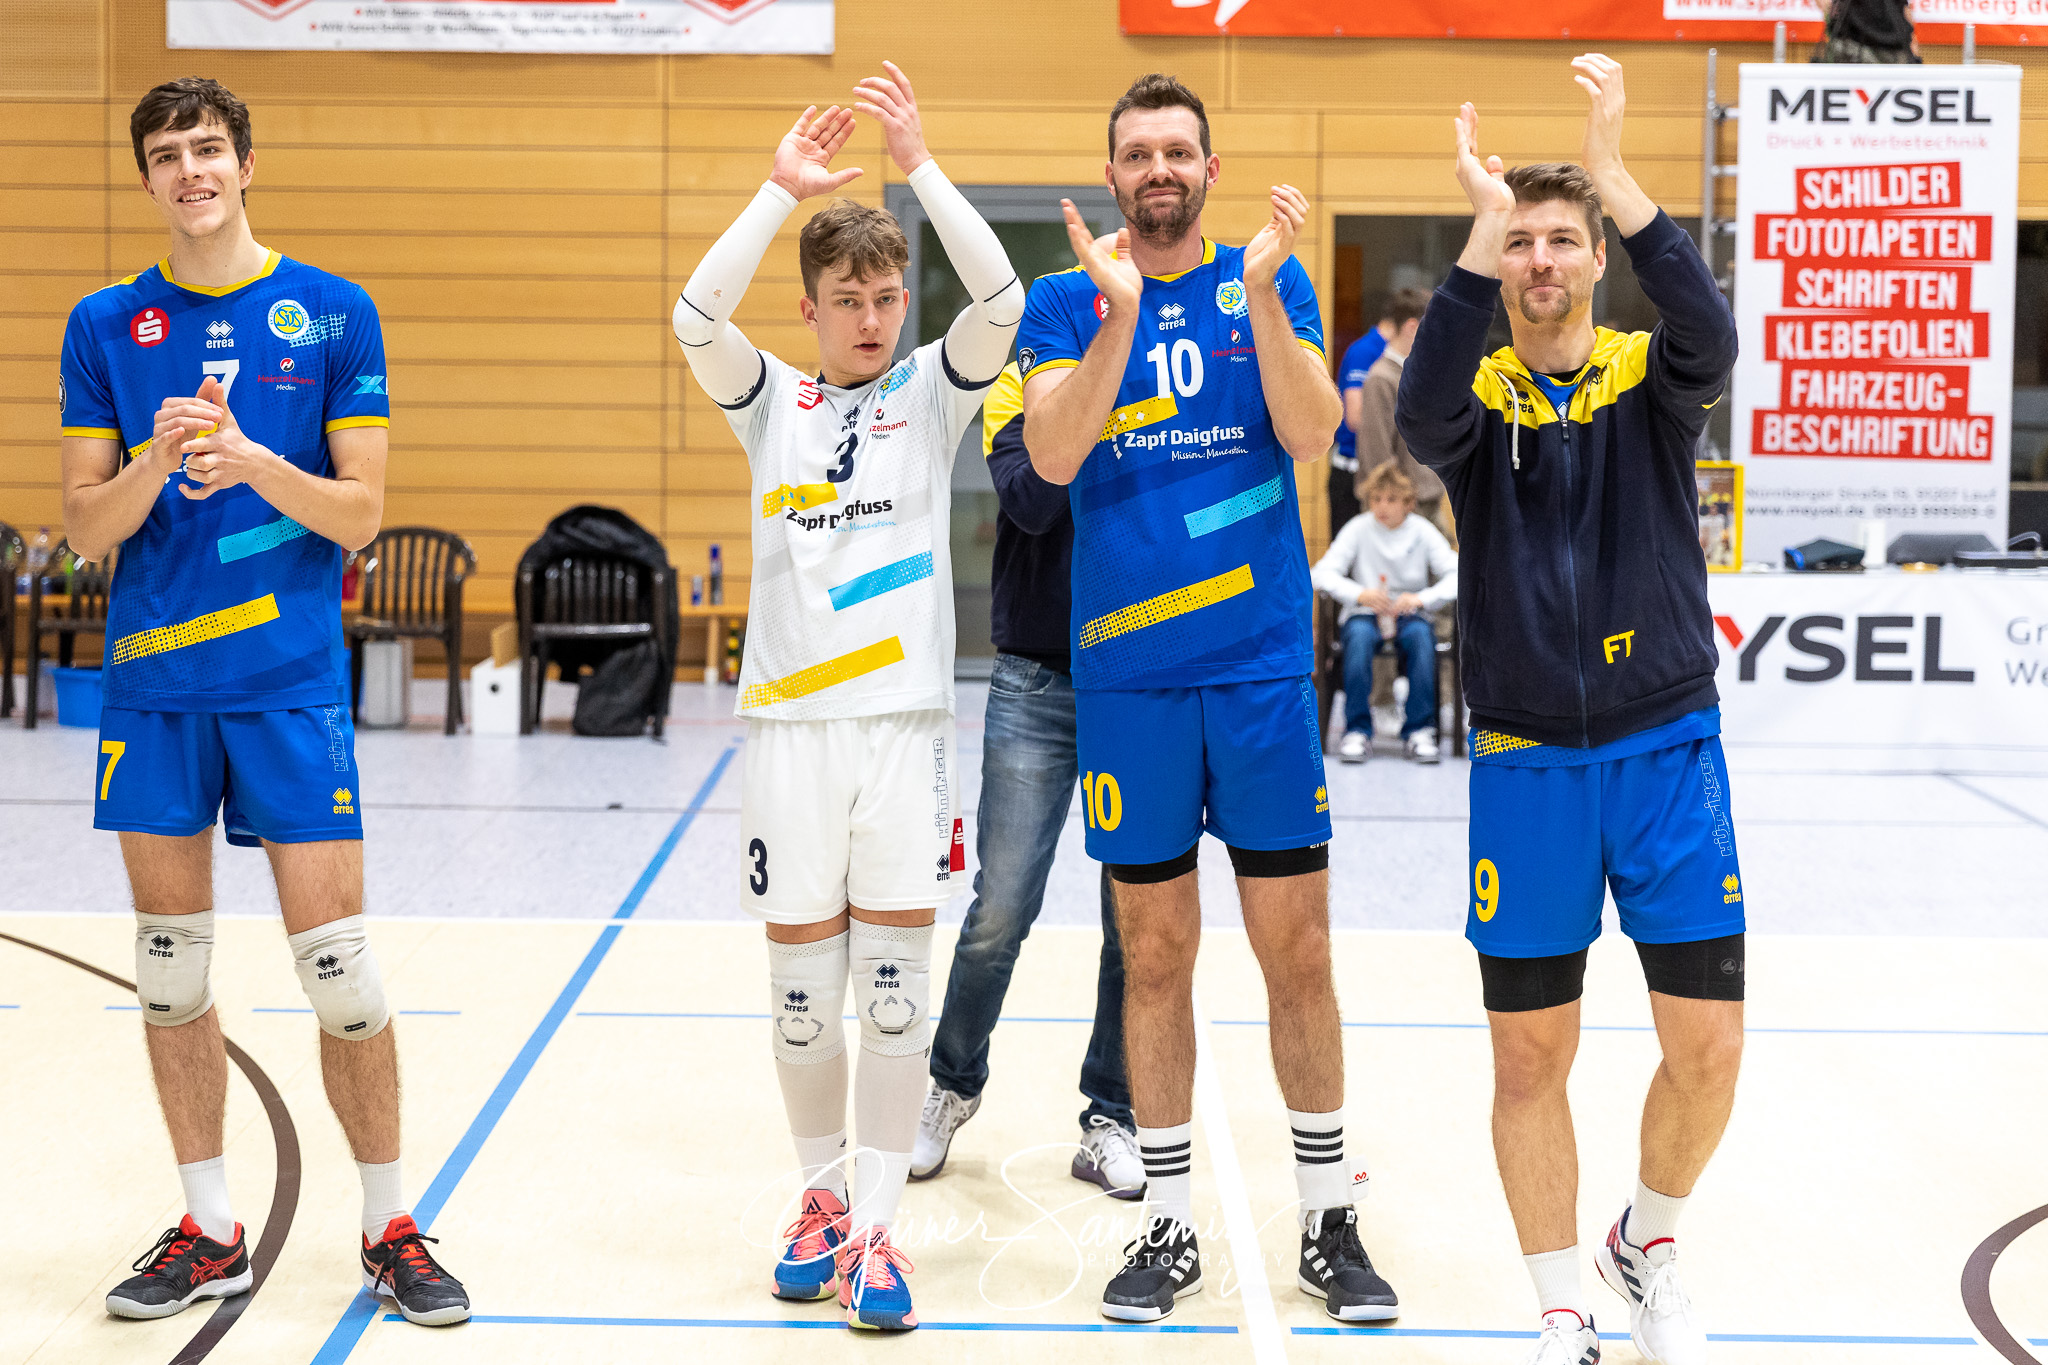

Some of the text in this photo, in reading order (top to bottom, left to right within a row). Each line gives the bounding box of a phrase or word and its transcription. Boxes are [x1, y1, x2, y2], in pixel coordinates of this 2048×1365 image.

[1769, 88, 1992, 123] MEYSEL
[1766, 133, 1988, 149] Druck Werbetechnik
[1802, 165, 1950, 210] SCHILDER
[1767, 217, 1977, 258] FOTOTAPETEN
[1795, 267, 1958, 310] SCHRIFTEN
[206, 338, 235, 349] errea
[1158, 317, 1186, 331] errea
[1776, 319, 1974, 360] KLEBEFOLIEN
[202, 359, 239, 400] 7
[1146, 338, 1204, 399] 10
[1790, 368, 1963, 411] FAHRZEUG-
[1124, 425, 1245, 451] Zapf Daigfuss
[1762, 413, 1989, 457] BESCHRIFTUNG
[827, 432, 859, 484] 3
[786, 506, 826, 532] Zapf
[1602, 629, 1635, 664] FT
[1713, 615, 1976, 683] YSEL
[100, 740, 126, 800] 7
[333, 805, 354, 814] errea
[1083, 770, 1123, 831] 10
[749, 837, 768, 896] 3
[1474, 858, 1499, 922] 9
[1723, 892, 1742, 904] errea
[148, 948, 174, 958] errea
[318, 966, 344, 980] errea
[874, 980, 900, 989] errea
[784, 1003, 809, 1013] errea
